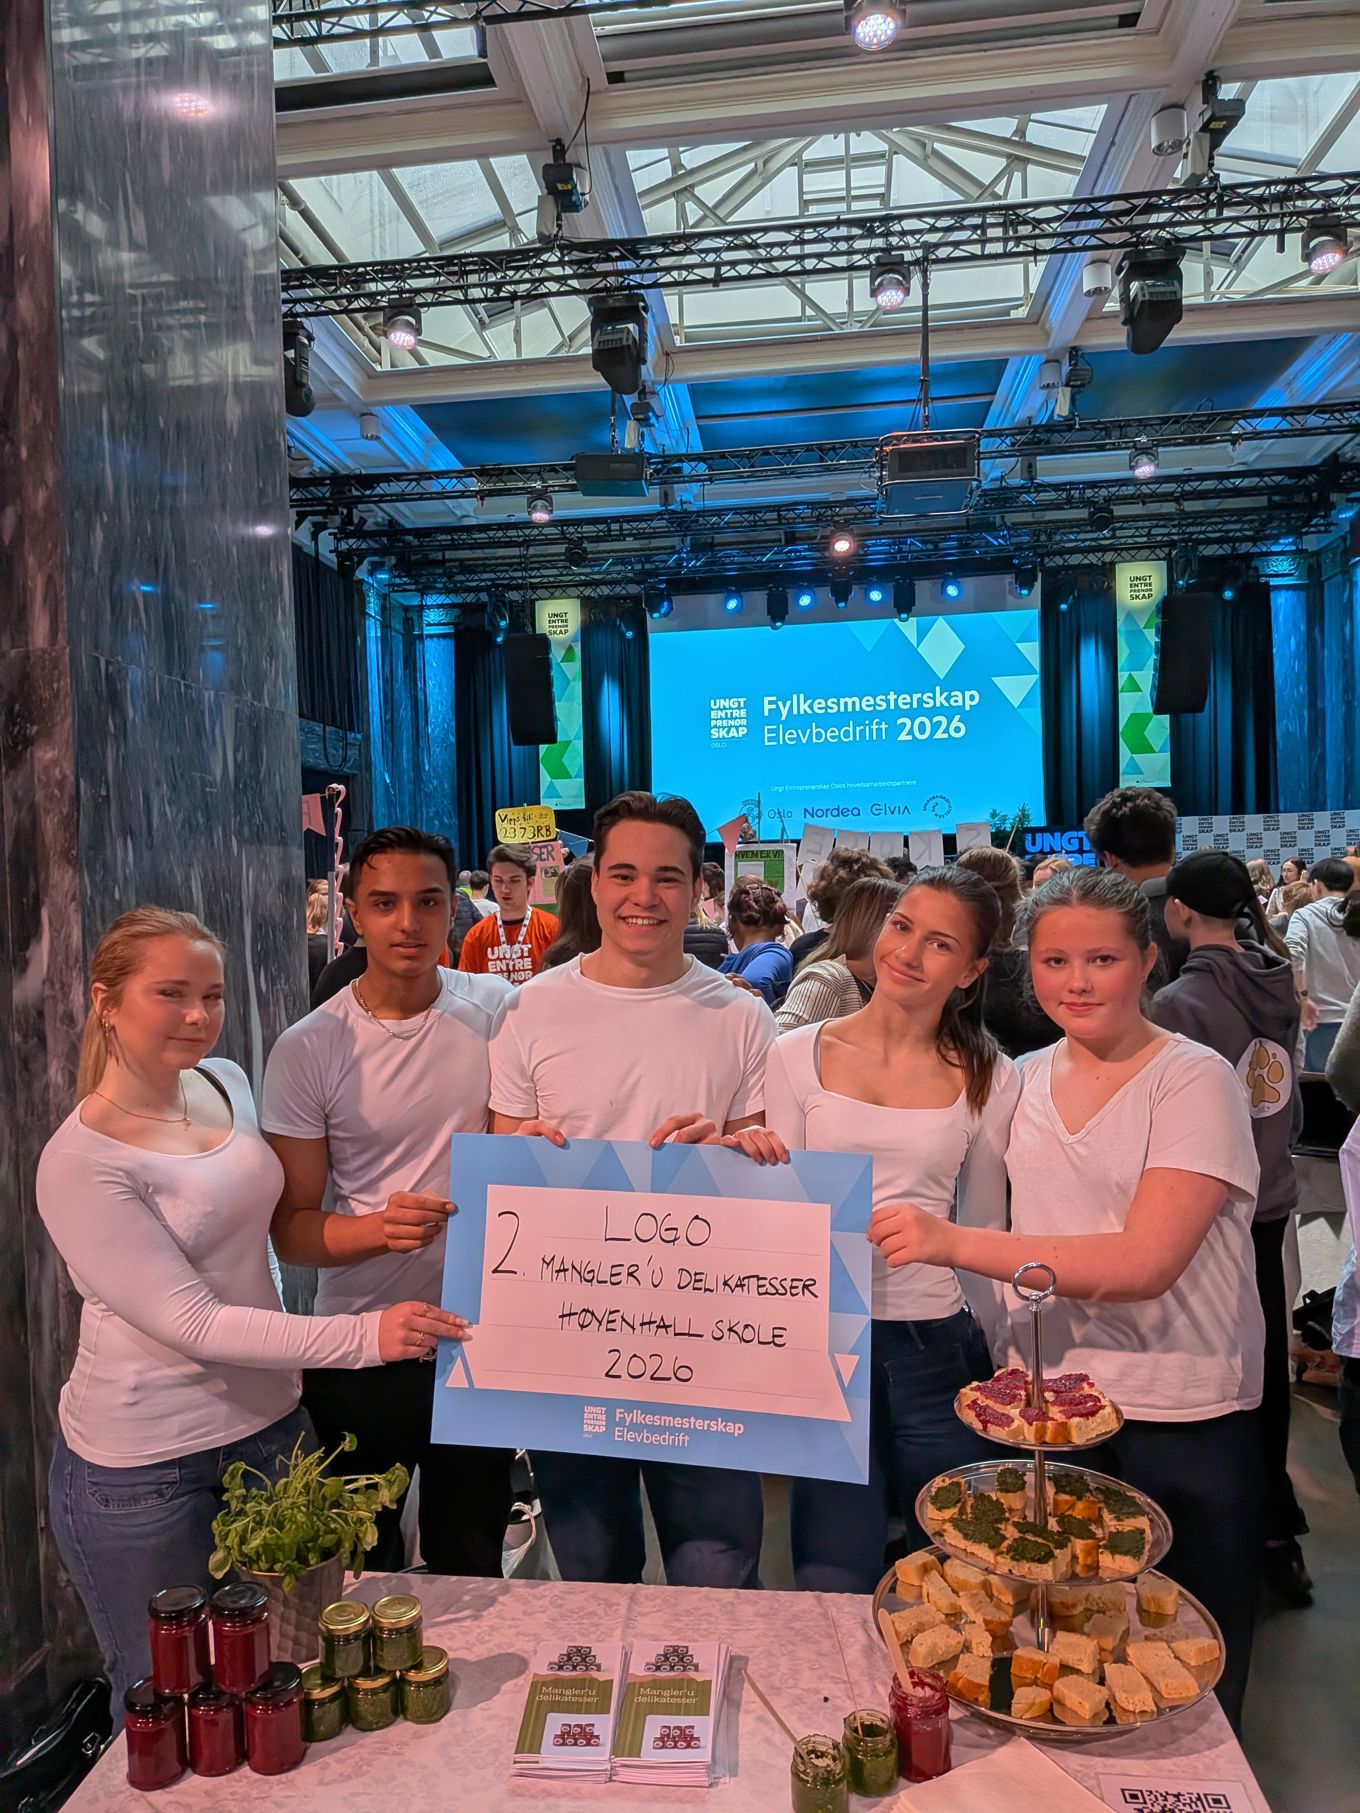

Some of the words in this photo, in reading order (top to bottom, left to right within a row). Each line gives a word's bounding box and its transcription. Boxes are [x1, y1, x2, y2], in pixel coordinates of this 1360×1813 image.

[711, 698, 746, 709] UNGT
[763, 686, 980, 720] Fylkesmesterskap
[711, 709, 746, 718] ENTRE
[711, 727, 747, 738] SKAP
[764, 719, 888, 746] Elevbedrift
[897, 715, 966, 741] 2026
[768, 808, 792, 819] Oslo
[804, 805, 860, 819] Nordea
[498, 813, 520, 826] Vipps
[500, 825, 552, 839] 2373RB
[1025, 831, 1091, 852] UNGT
[488, 944, 531, 959] UNGT
[488, 958, 532, 972] ENTRE
[605, 1205, 712, 1246] LOGO
[491, 1210, 526, 1277] 2.
[677, 1268, 819, 1299] DELIKATESSER
[558, 1301, 704, 1338] HØYENHALL
[712, 1320, 788, 1347] SKOLE
[604, 1349, 694, 1382] 2026
[584, 1406, 606, 1414] UNGT
[584, 1424, 605, 1432] SKAP
[615, 1408, 744, 1436] Fylkesmesterskap
[614, 1428, 690, 1447] Elevbedrift
[536, 1694, 599, 1702] delikatesser
